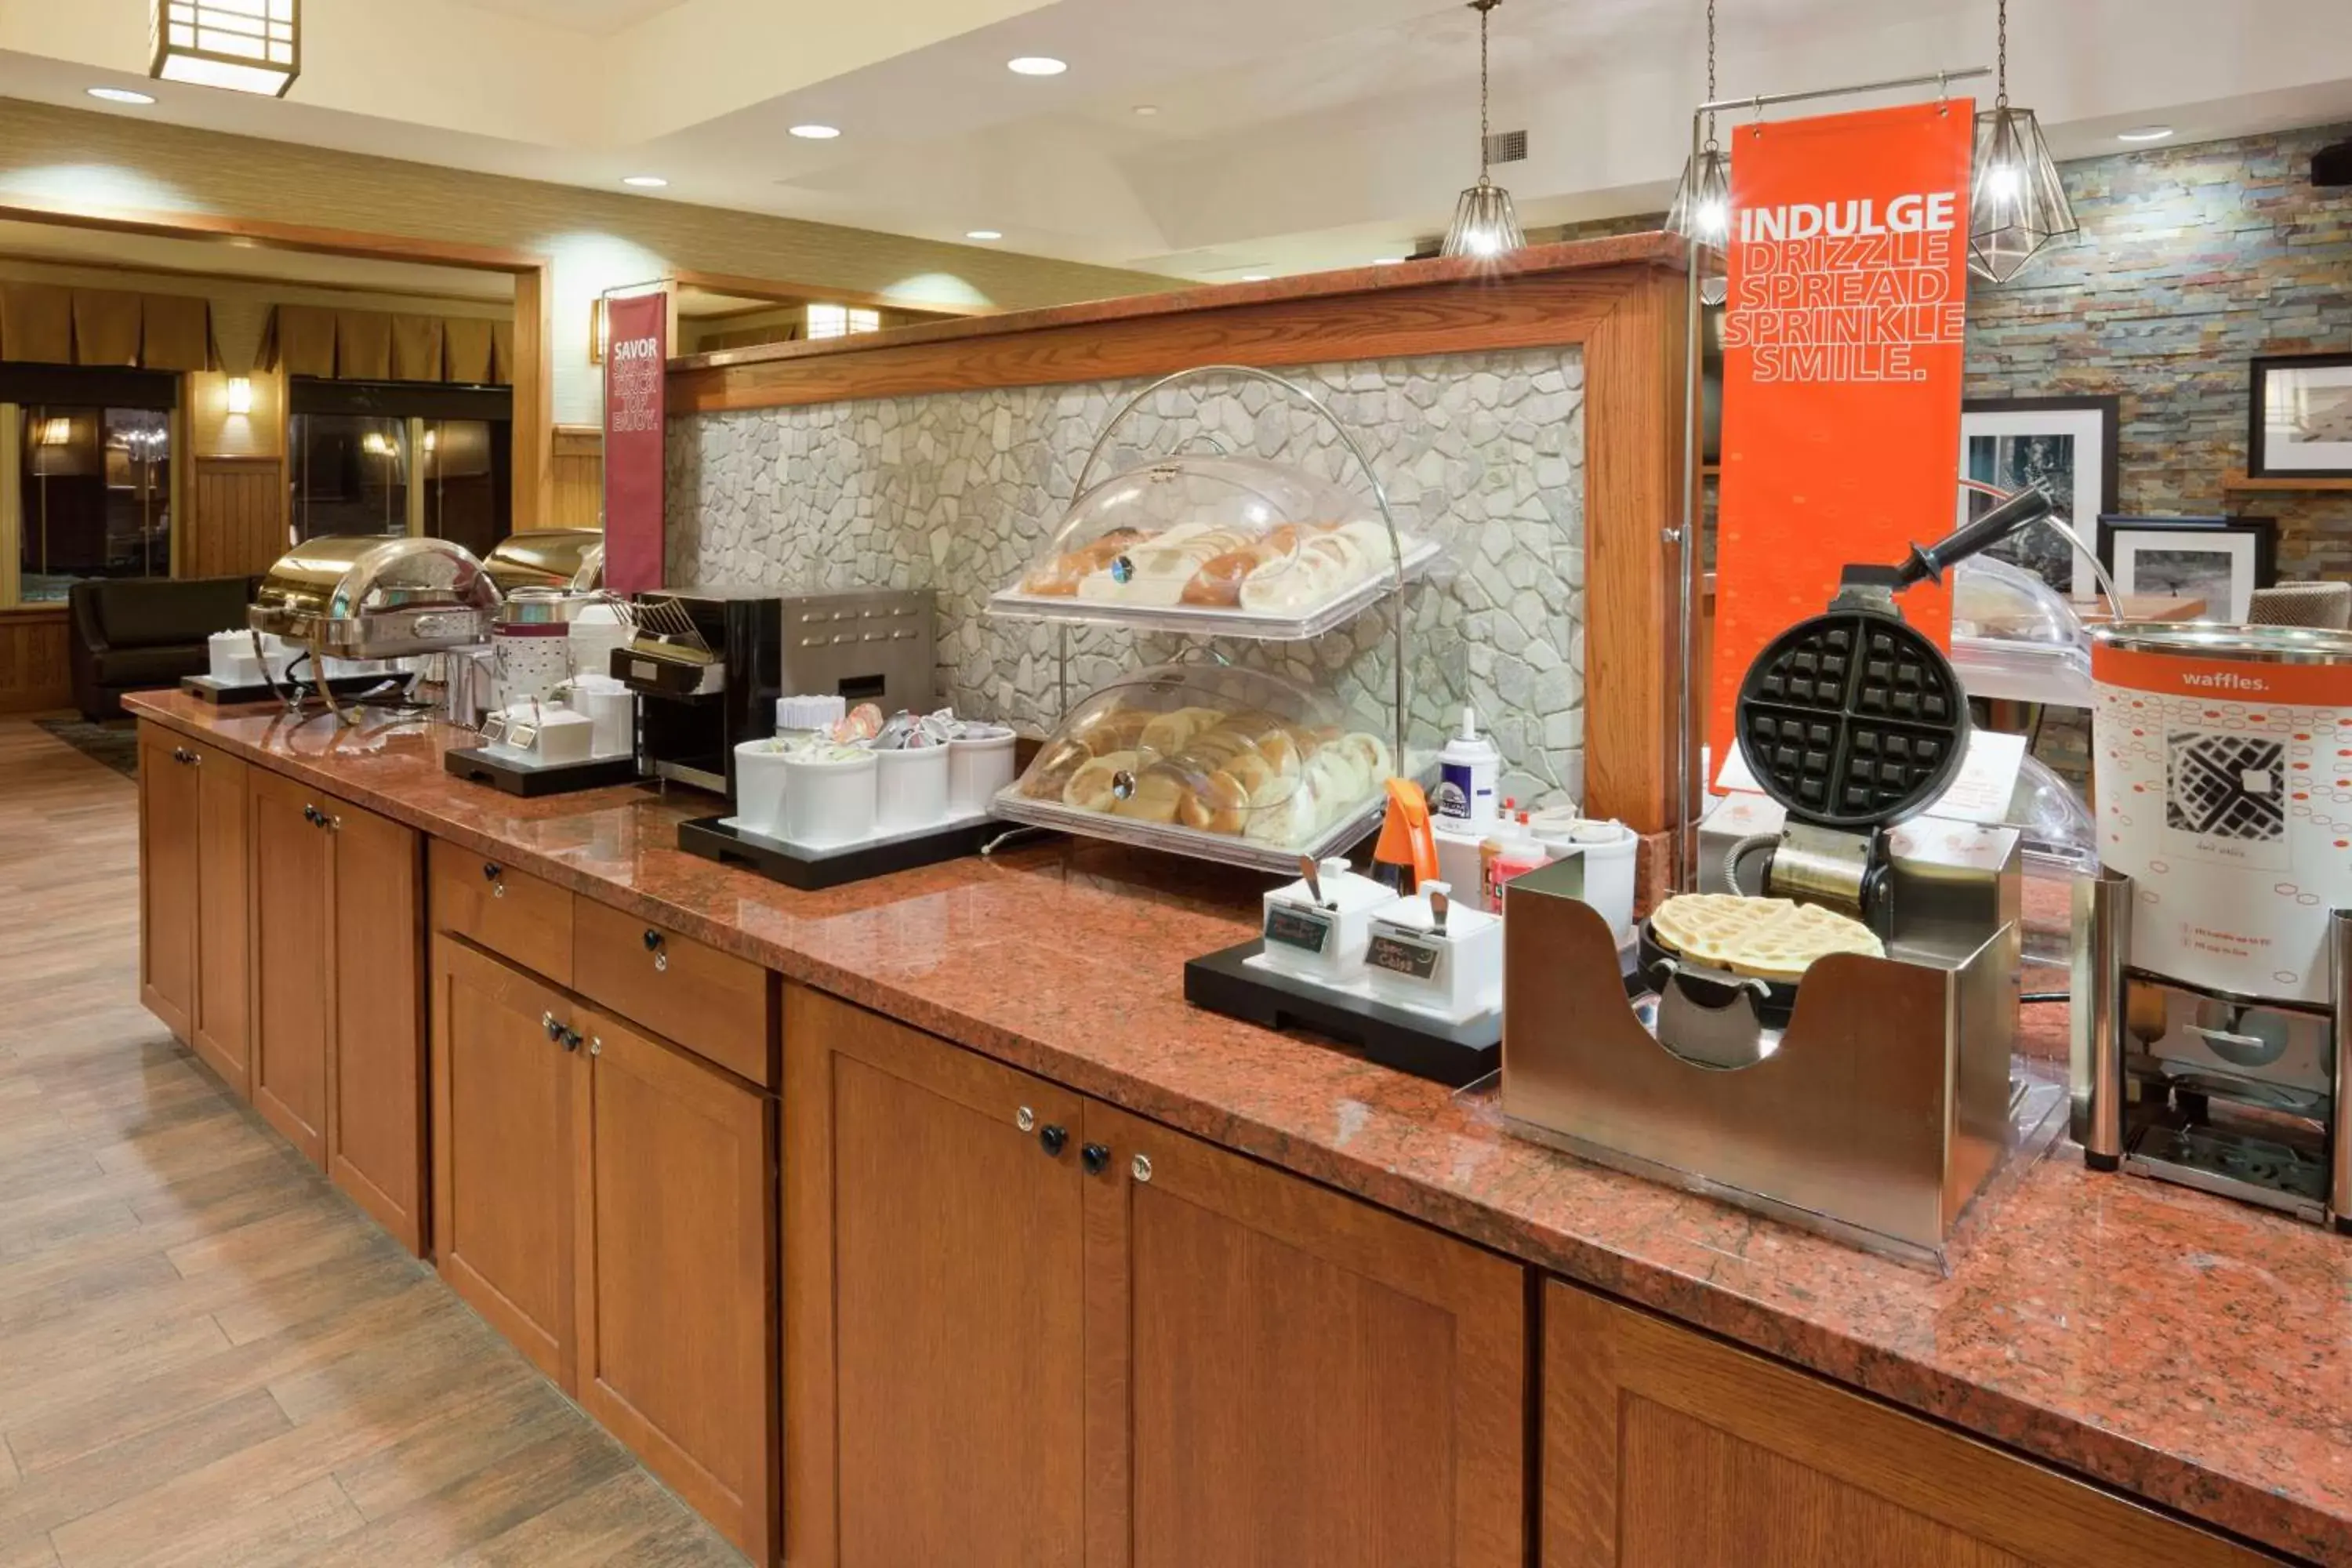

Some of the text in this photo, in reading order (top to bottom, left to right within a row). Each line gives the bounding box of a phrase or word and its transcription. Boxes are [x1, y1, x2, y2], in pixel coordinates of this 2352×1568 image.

[1740, 192, 1955, 242] INDULGE
[1742, 229, 1950, 277] DRIZZLE
[1739, 267, 1949, 311] SPREAD
[1722, 303, 1965, 347] SPRINKLE
[614, 338, 657, 360] SAVOR
[1751, 342, 1926, 383] SMILE.
[2183, 672, 2270, 691] waffles.
